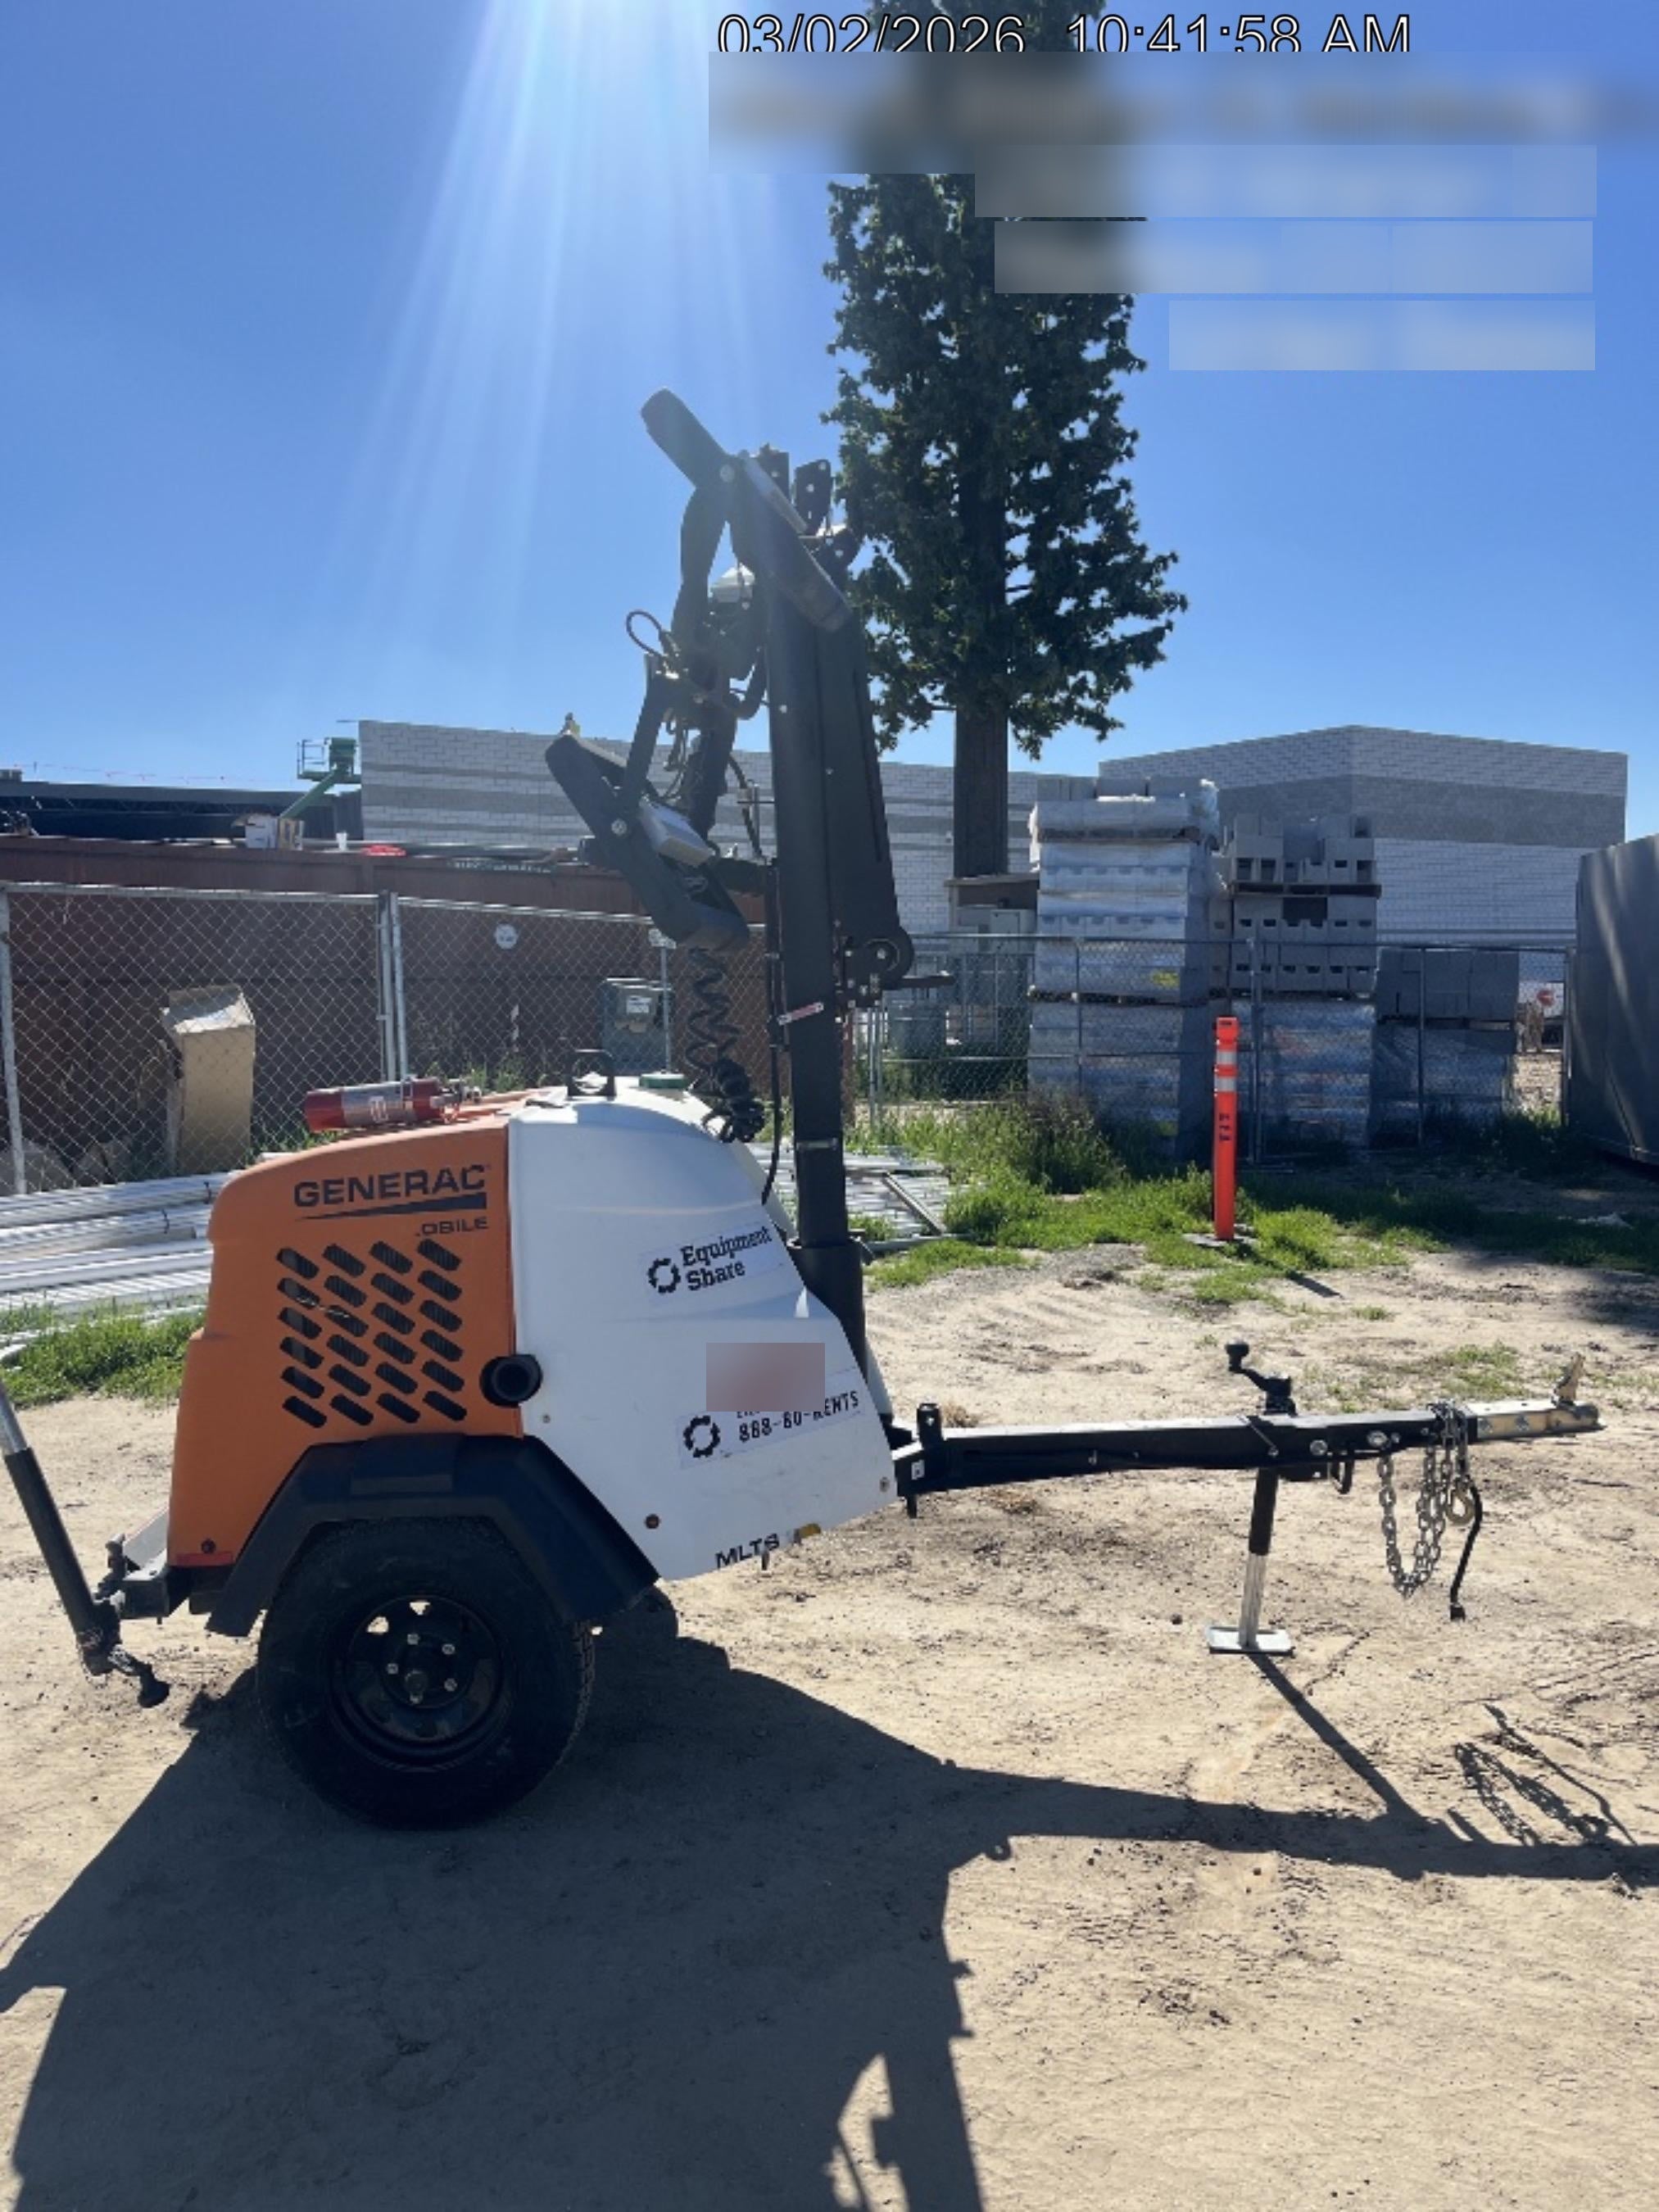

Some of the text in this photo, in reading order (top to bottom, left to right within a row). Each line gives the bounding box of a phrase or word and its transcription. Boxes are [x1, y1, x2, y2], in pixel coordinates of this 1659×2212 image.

[293, 1164, 486, 1208] GENERAC
[680, 1226, 773, 1267] Equipment
[686, 1262, 746, 1291] Share
